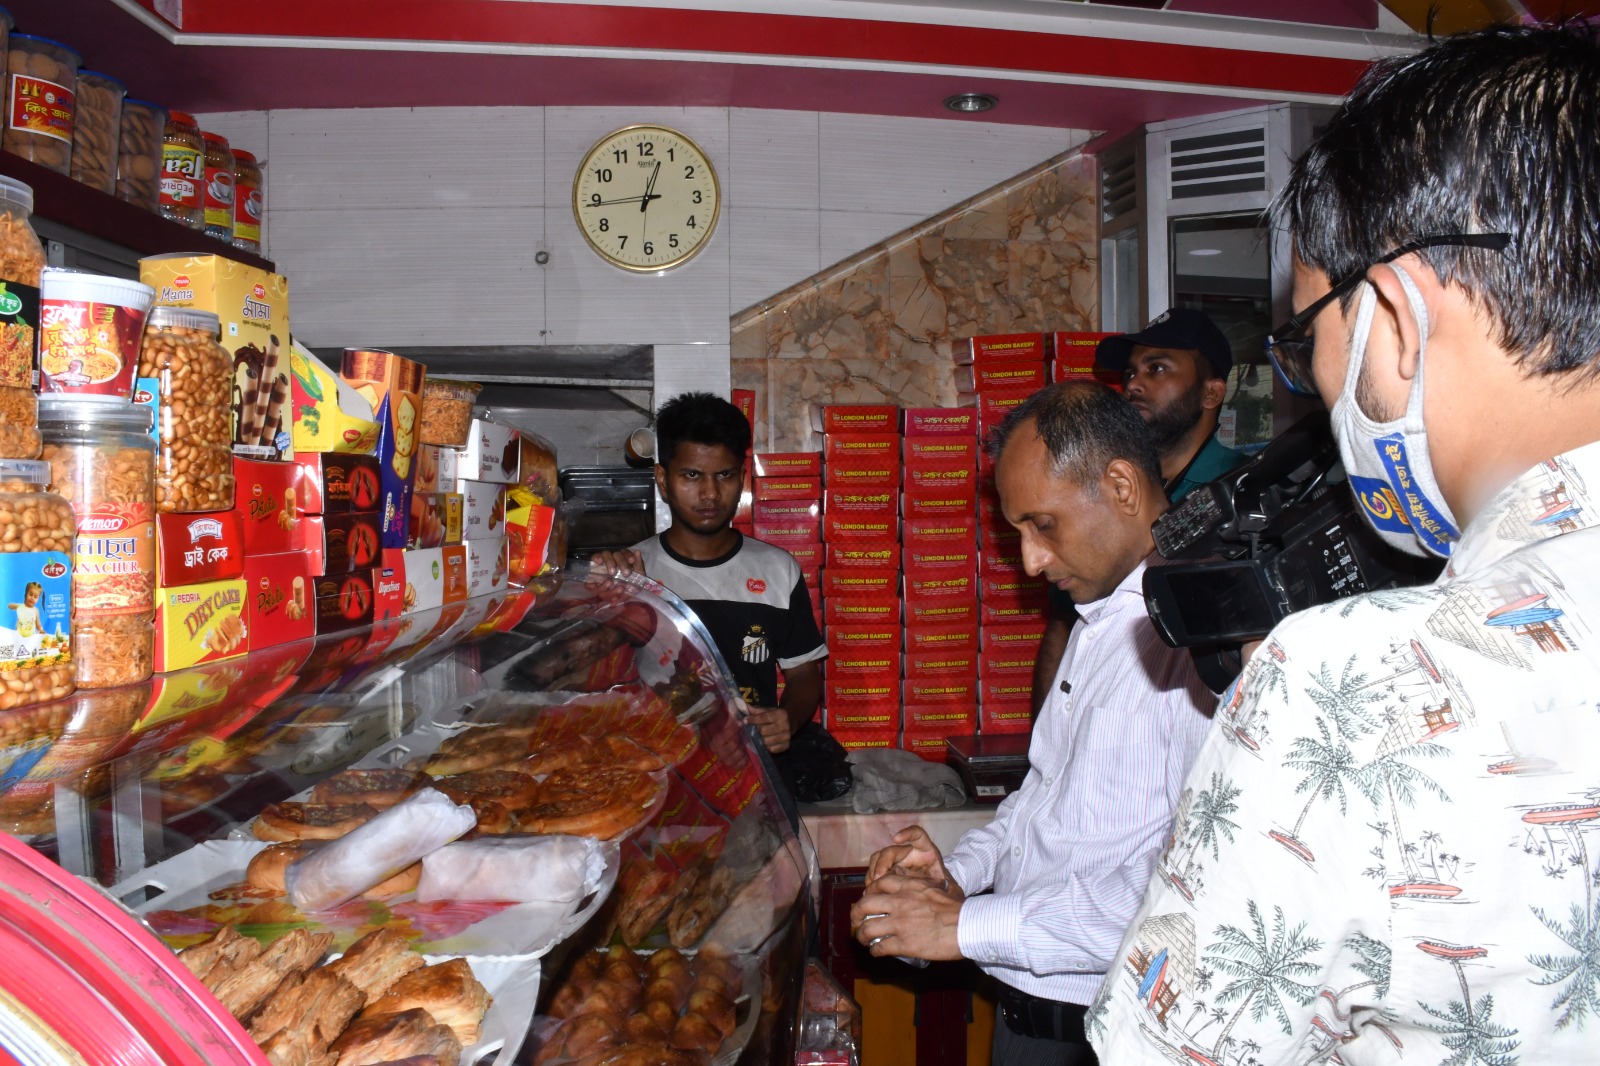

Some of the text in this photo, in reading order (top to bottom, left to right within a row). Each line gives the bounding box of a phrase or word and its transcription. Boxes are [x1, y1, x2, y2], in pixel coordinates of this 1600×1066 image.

[637, 142, 654, 157] 12
[613, 150, 628, 163] 11
[667, 148, 674, 162] 1
[165, 155, 201, 180] Tea
[684, 165, 695, 179] 2
[594, 169, 612, 183] 10
[591, 193, 602, 207] 9
[692, 190, 702, 204] 3
[599, 218, 609, 232] 8
[686, 215, 697, 229] 4
[617, 236, 629, 250] 7
[669, 233, 679, 248] 5
[643, 242, 654, 255] 6
[160, 288, 193, 301] Mama
[242, 295, 271, 319] মামা
[987, 341, 1035, 350] LONDON BAKERY
[988, 369, 1036, 379] LONDON BAKERY
[840, 414, 889, 422] LONDON BAKERY
[842, 441, 891, 449] LONDON BAKERY
[920, 444, 968, 452] LONDON BAKERY
[920, 499, 968, 507] LONDON BAKERY
[839, 523, 889, 531] LONDON BAKERY
[920, 527, 968, 535] LONDON BAKERY
[77, 538, 137, 560] নাচুর
[184, 546, 228, 568] ড্রাই কেক
[920, 554, 968, 562] LONDON BAKERY
[840, 577, 889, 585] LONDON BAKERY
[183, 588, 241, 641] DRY CAKE
[922, 606, 970, 615] LONDON BAKERY
[844, 632, 892, 640] LONDON BAKERY
[922, 633, 970, 642] LONDON BAKERY
[843, 659, 891, 667] LONDON BAKERY
[922, 660, 969, 669] LONDON BAKERY
[842, 687, 891, 695] LONDON BAKERY
[920, 686, 968, 695] LONDON BAKERY
[843, 714, 891, 722] LONDON BAKERY
[920, 712, 968, 721] LONDON BAKERY
[841, 740, 890, 748] LONDON BAKERY
